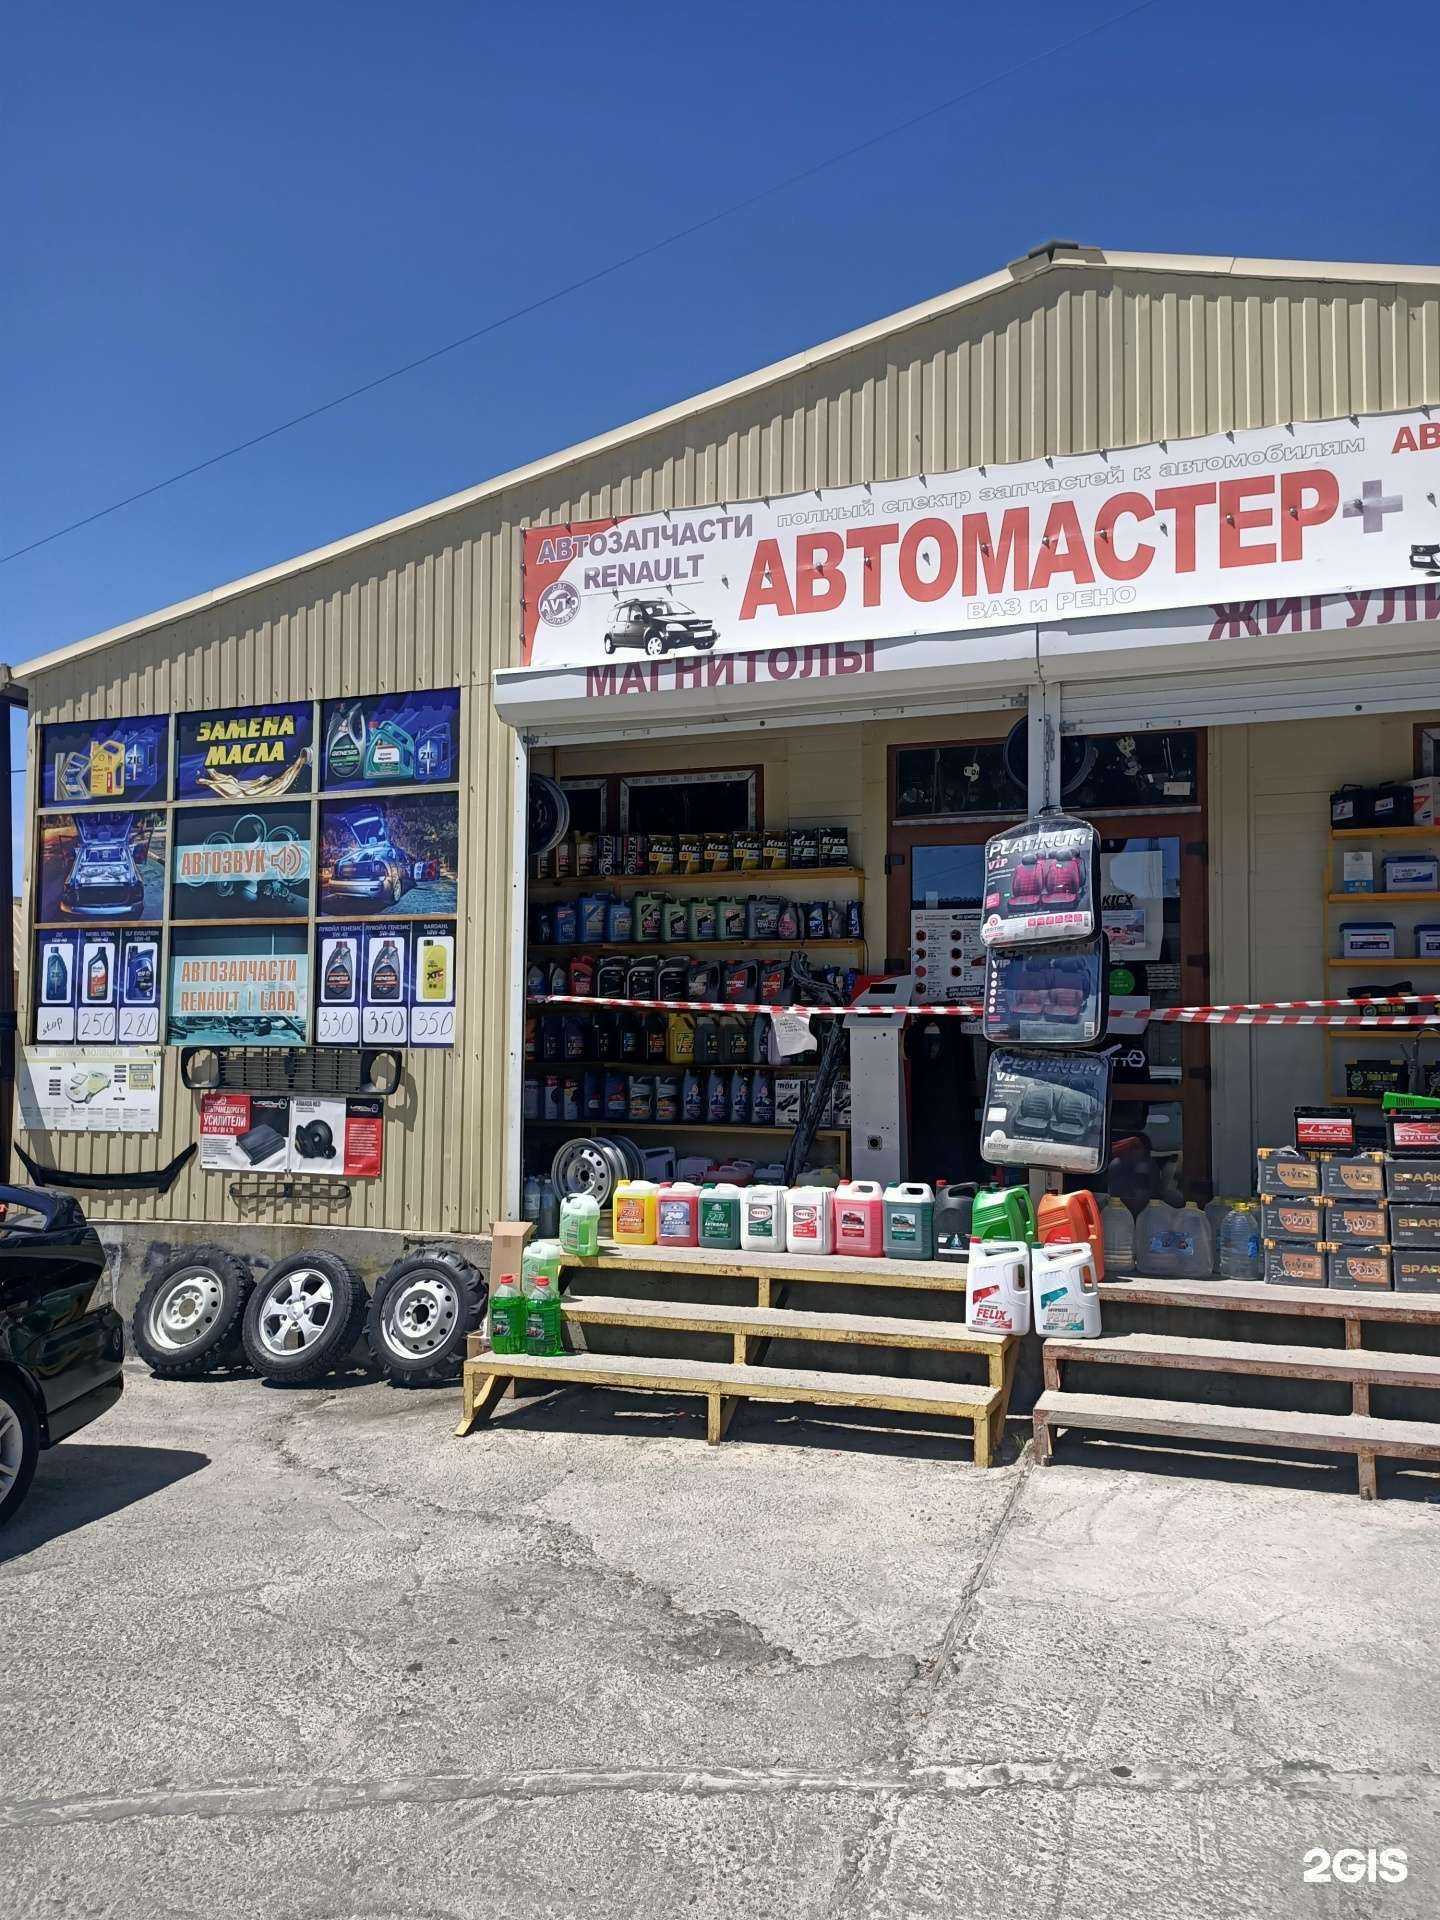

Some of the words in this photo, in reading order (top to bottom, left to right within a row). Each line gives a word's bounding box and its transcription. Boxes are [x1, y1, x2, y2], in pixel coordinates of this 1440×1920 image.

[777, 499, 875, 527] полный
[882, 490, 971, 515] спектр
[980, 465, 1125, 500] запчастей
[1133, 465, 1151, 481] к
[1159, 437, 1365, 477] автомобилям
[536, 514, 753, 565] АВТОЗАПЧАСТИ
[584, 554, 705, 590] RENAULT
[967, 598, 1022, 620] ВАЗ
[1030, 598, 1048, 613] и
[1056, 585, 1137, 610] РЕНО
[586, 640, 875, 698] МАГНИТОЛЫ
[196, 715, 295, 742] ЗАМЕНА
[205, 741, 285, 766] МАСЛА
[822, 836, 847, 844] Kixx
[989, 830, 1087, 858] PLATINUM
[181, 849, 265, 875] АВТОЗВУК
[182, 960, 297, 982] АВТОЗАПЧАСТИ
[181, 991, 239, 1011] RENAULT
[260, 990, 296, 1011] LADA
[82, 1012, 114, 1036] 250
[320, 1012, 353, 1037] 330
[367, 1011, 404, 1036] 350
[414, 1011, 453, 1035] 350
[204, 1113, 246, 1127] УСИЛИТЕЛИ
[976, 1308, 1008, 1320] FELIX
